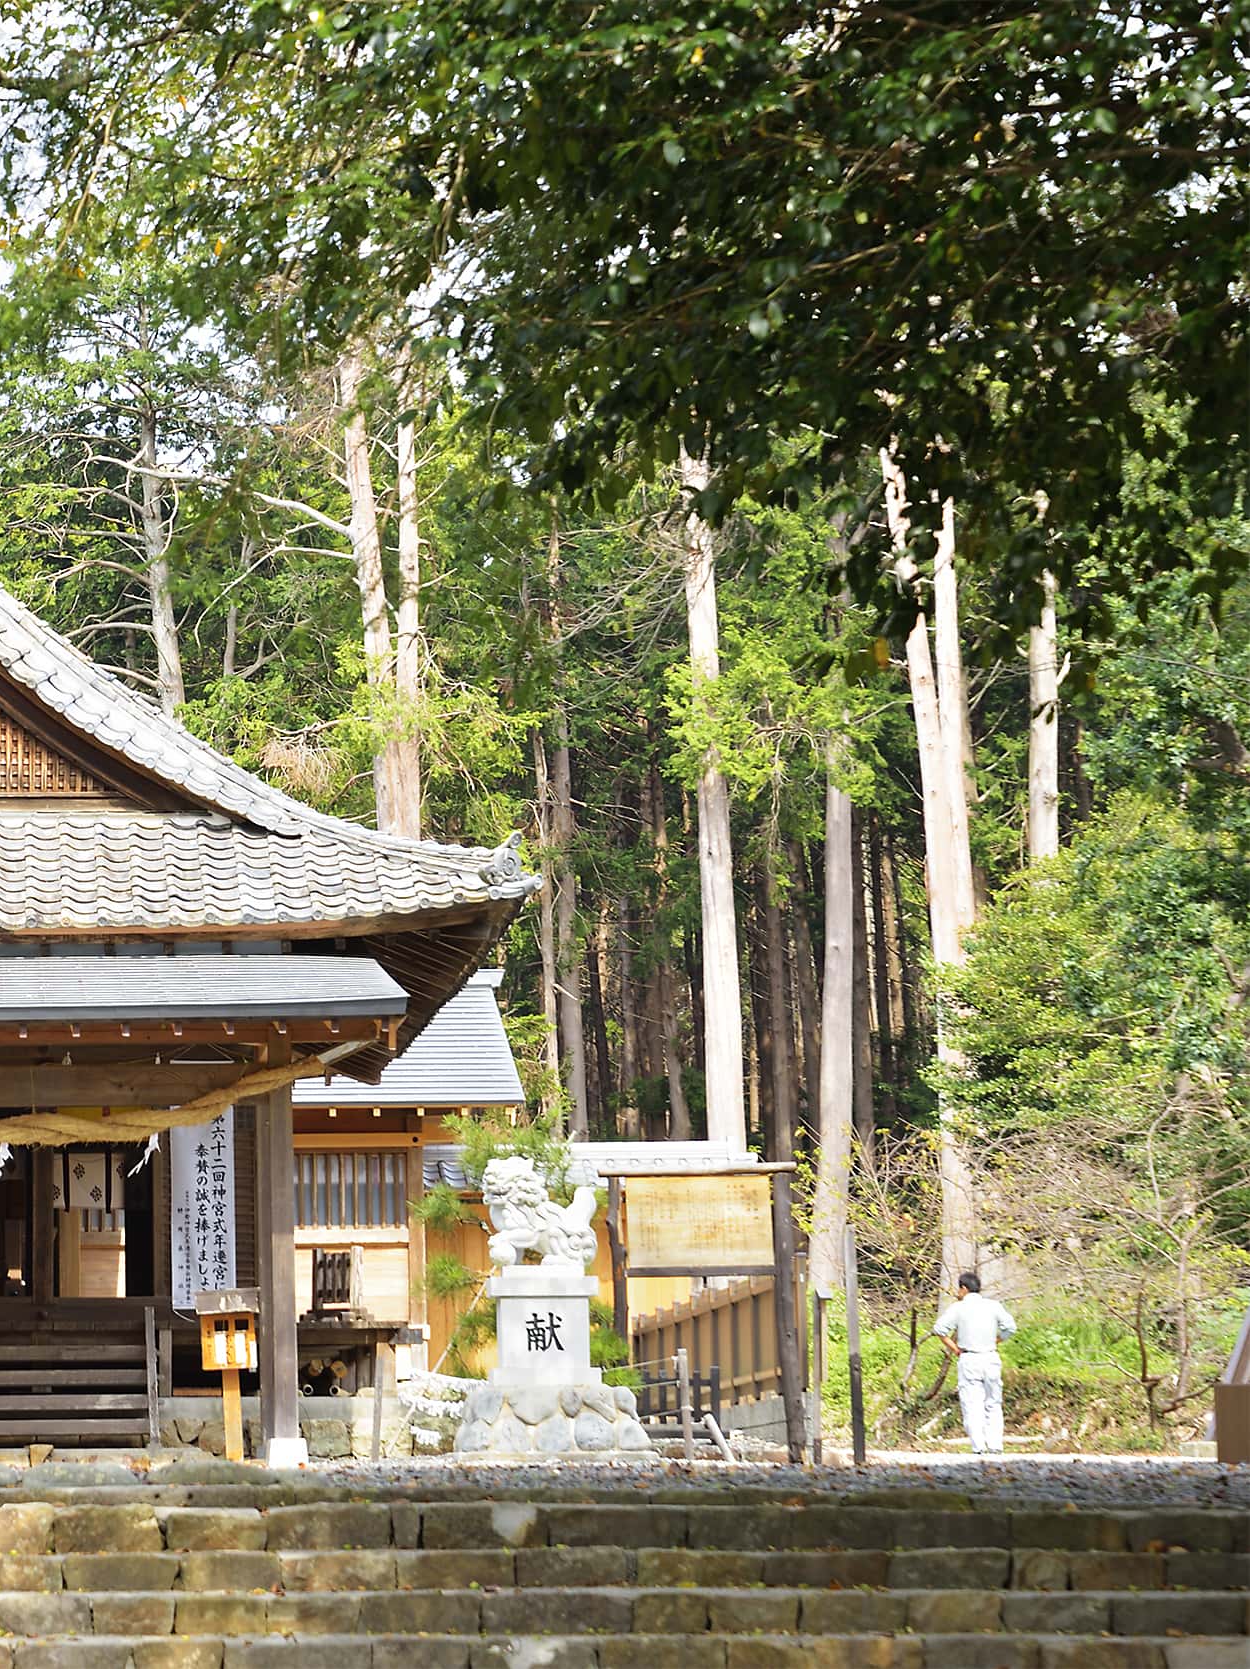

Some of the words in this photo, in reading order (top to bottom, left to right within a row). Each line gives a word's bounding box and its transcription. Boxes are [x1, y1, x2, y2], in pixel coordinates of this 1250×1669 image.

[194, 1143, 211, 1291] 奉賛の誠を捧げましょ
[525, 1312, 565, 1351] 献
